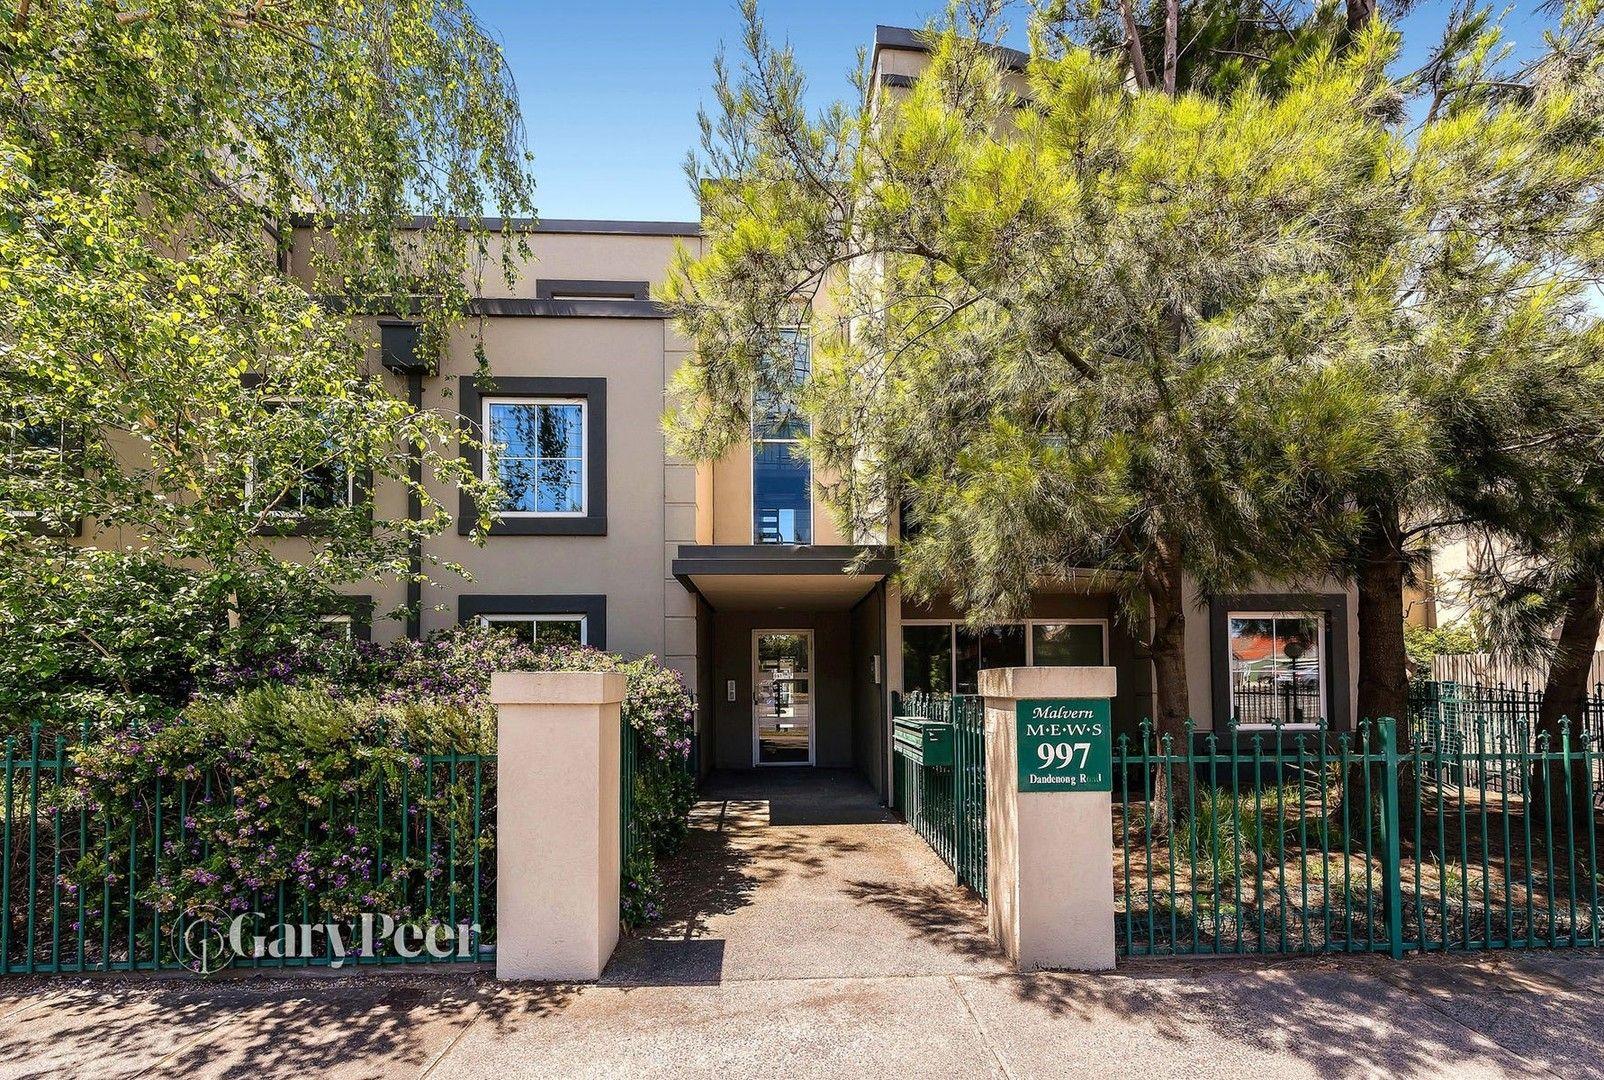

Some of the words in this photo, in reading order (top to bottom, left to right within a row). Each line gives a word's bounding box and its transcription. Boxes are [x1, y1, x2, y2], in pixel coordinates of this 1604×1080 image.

[1032, 705, 1094, 719] Malvern
[1037, 742, 1091, 769] 997
[1029, 774, 1076, 786] Dandenong
